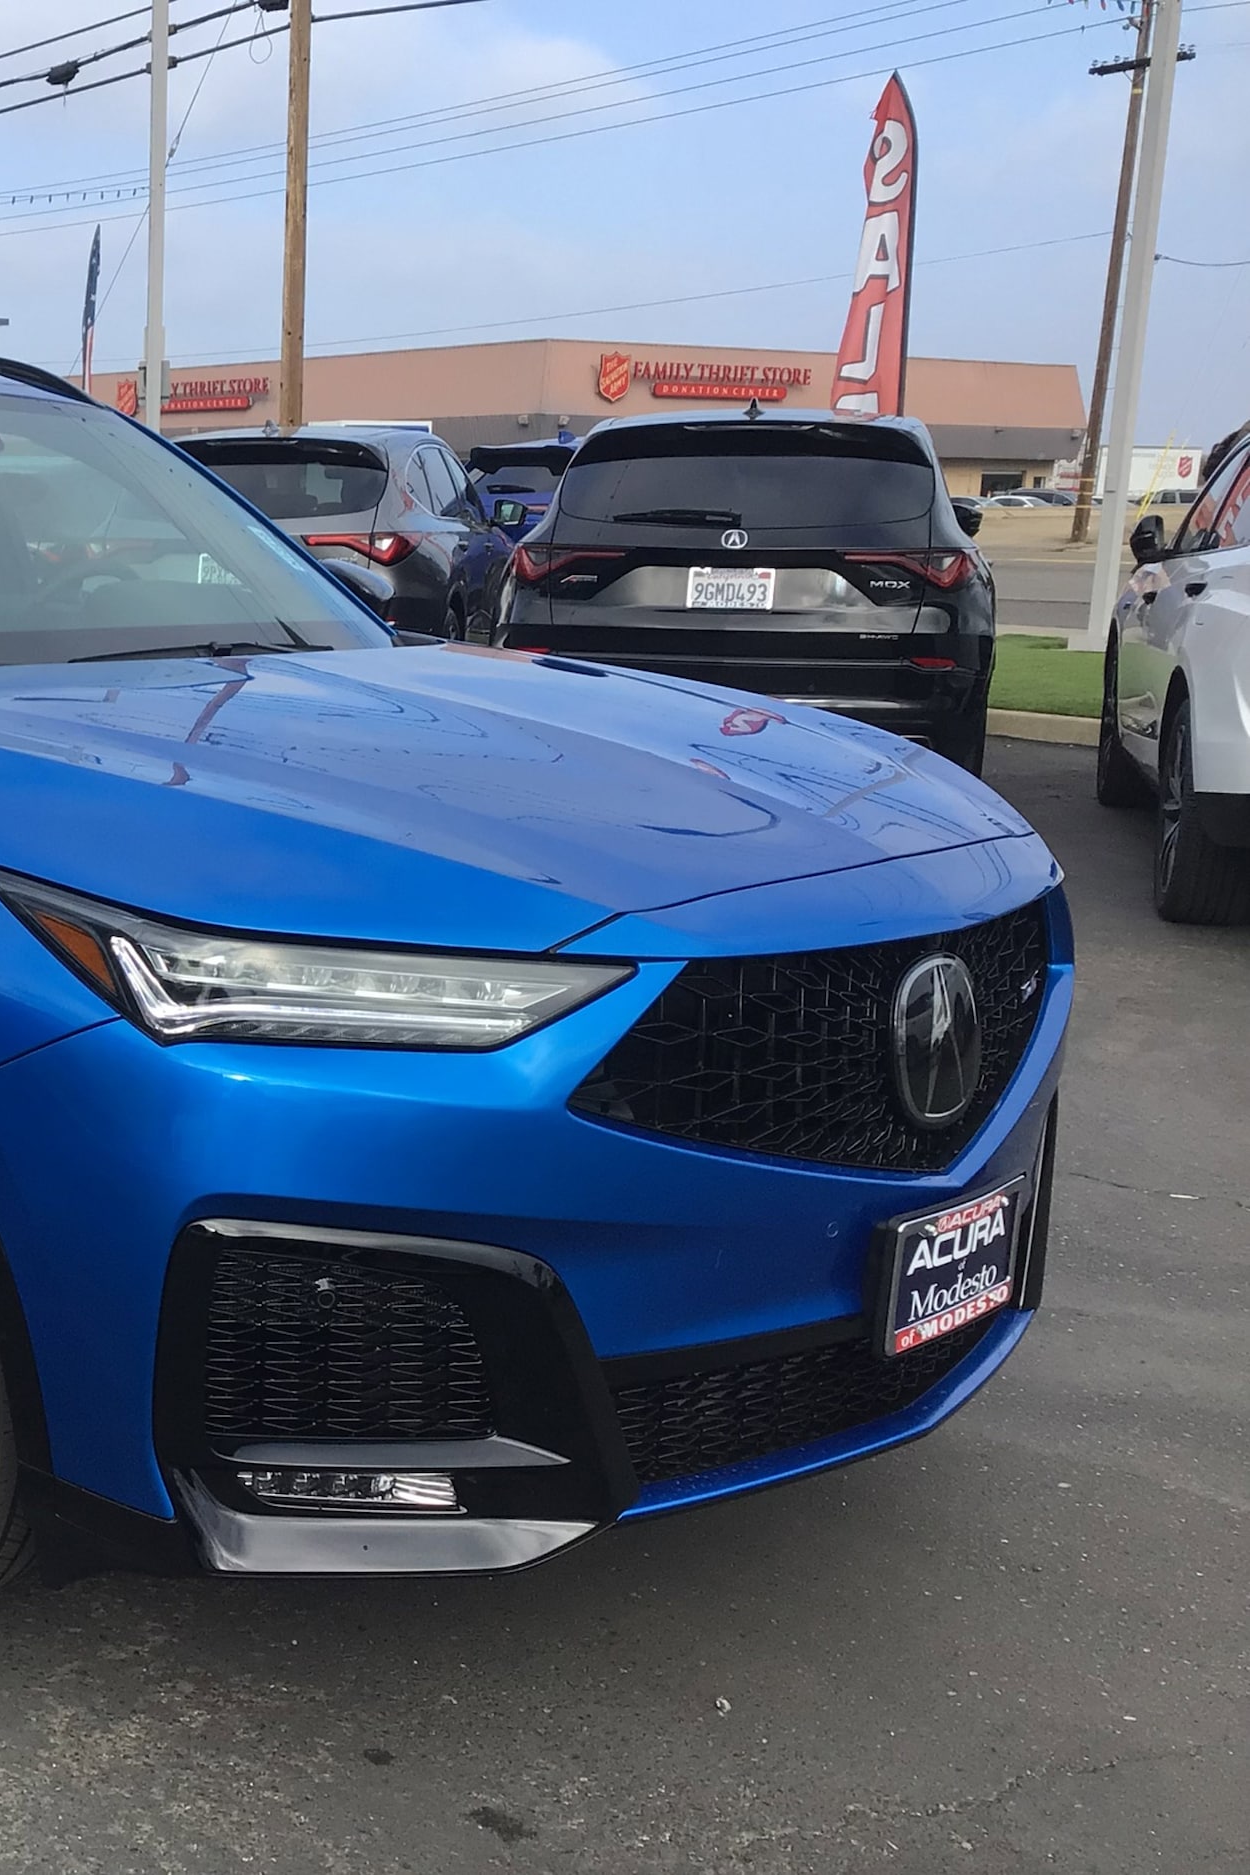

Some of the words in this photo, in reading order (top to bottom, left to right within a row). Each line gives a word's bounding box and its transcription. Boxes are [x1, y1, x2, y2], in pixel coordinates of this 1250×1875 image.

[633, 360, 694, 380] FAMILY
[697, 363, 759, 384] THRIFT
[762, 366, 812, 386] STORE
[181, 380, 226, 398] THRIFT
[228, 376, 269, 395] STORE
[662, 385, 728, 396] DONATION
[732, 386, 779, 397] CENTER
[694, 582, 768, 602] 9GMD493
[870, 580, 910, 589] MDX
[907, 1208, 1006, 1276] ACURA
[958, 1259, 966, 1271] of
[908, 1264, 997, 1322] Modesto
[901, 1331, 916, 1347] of
